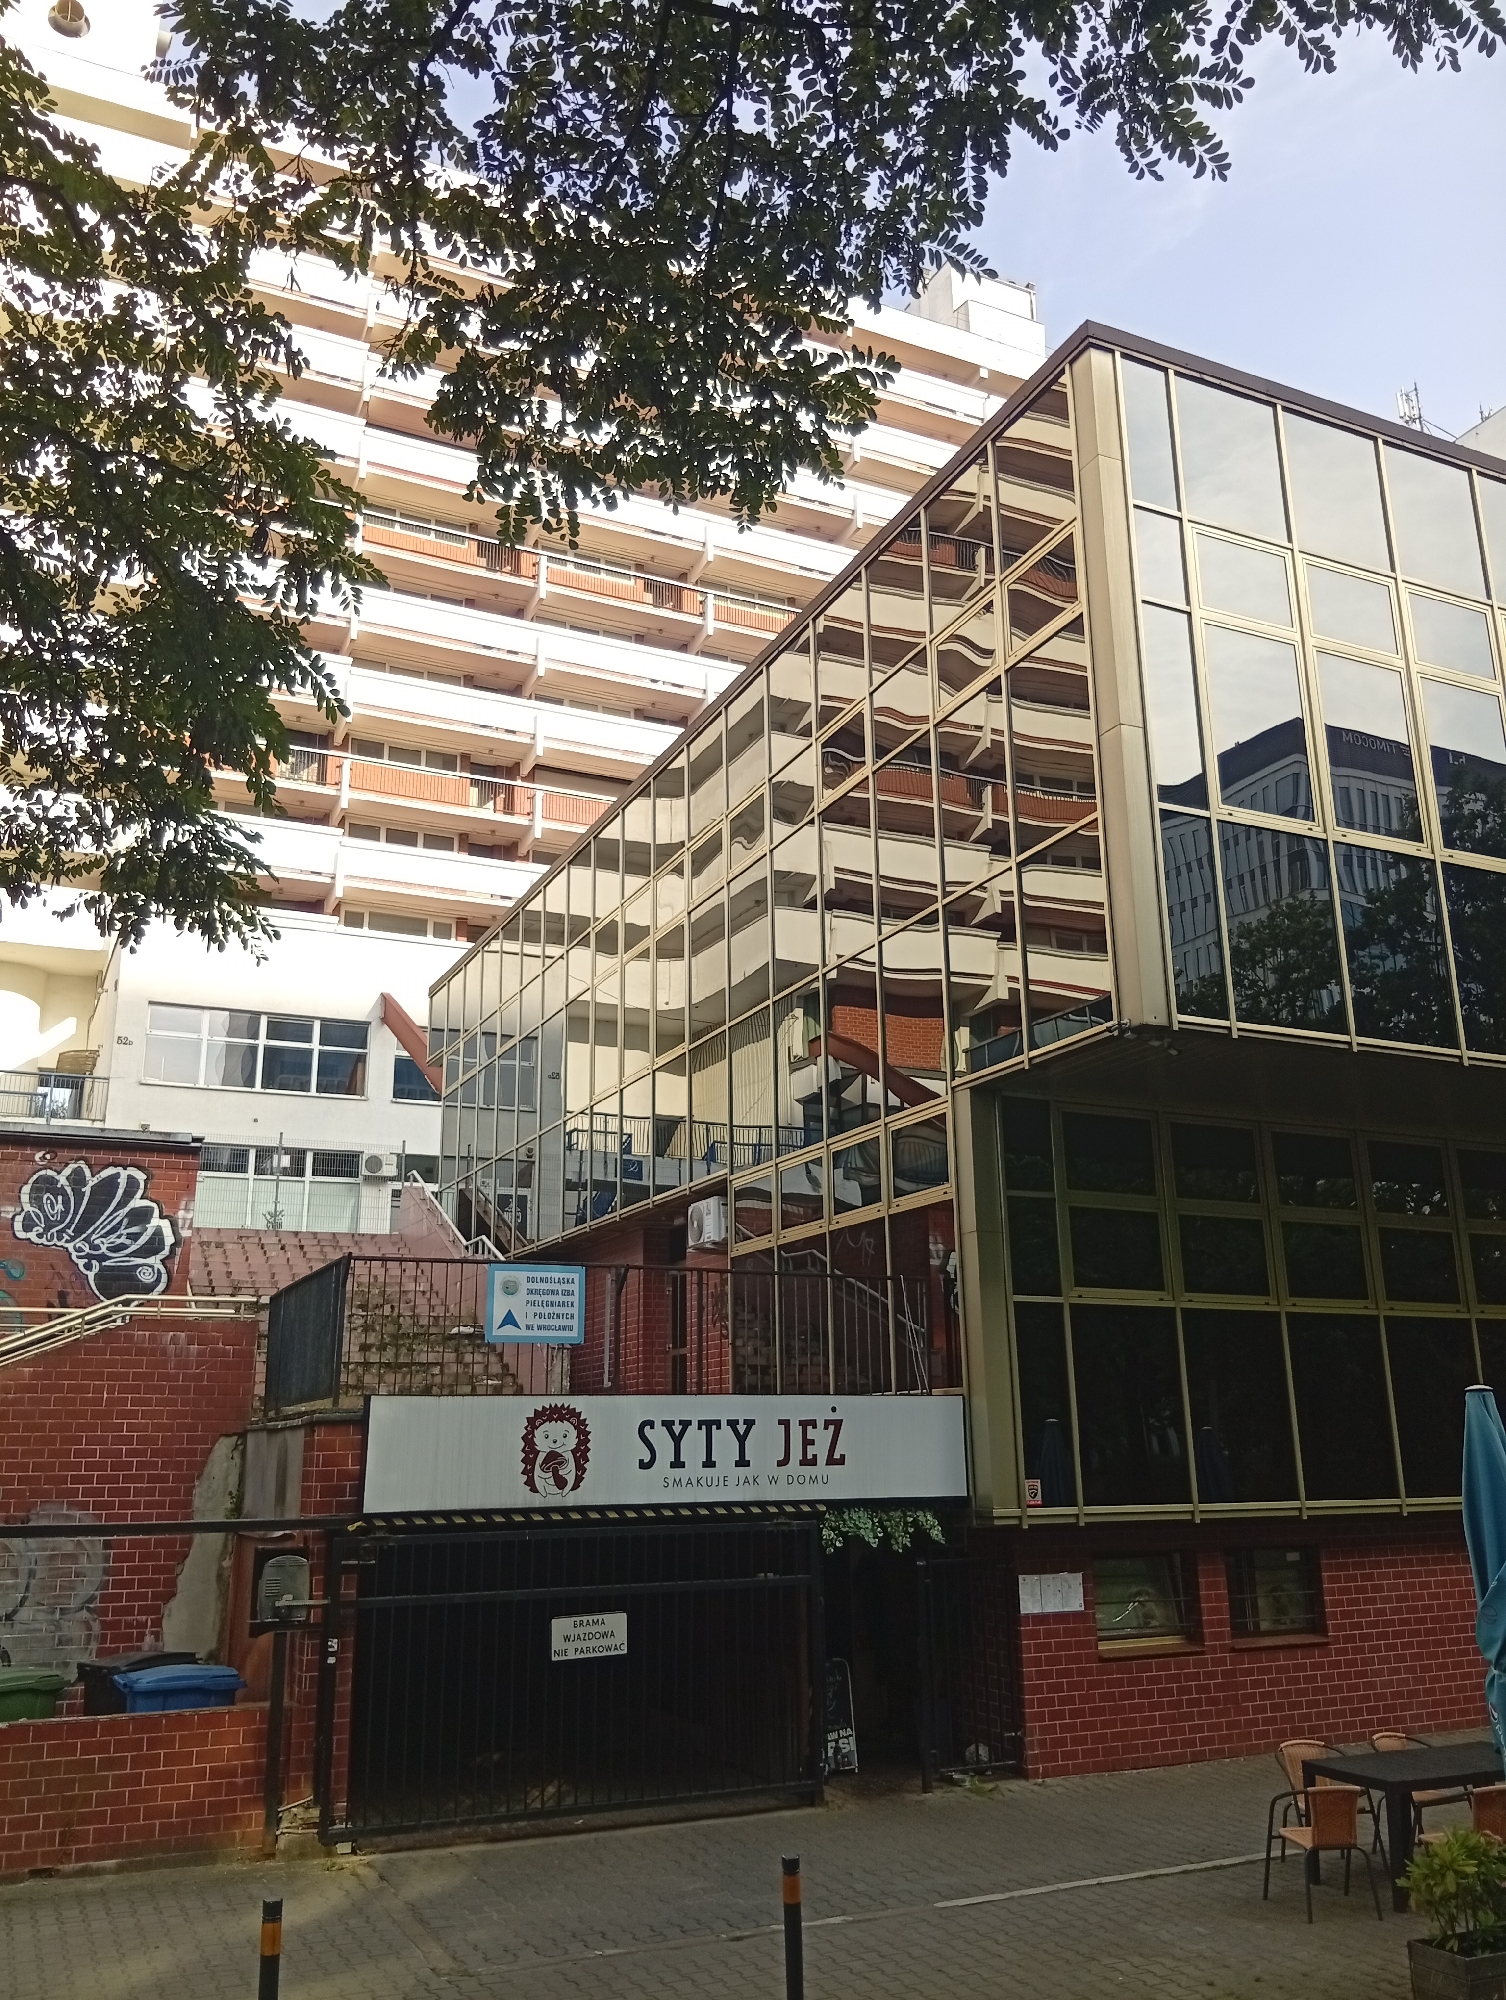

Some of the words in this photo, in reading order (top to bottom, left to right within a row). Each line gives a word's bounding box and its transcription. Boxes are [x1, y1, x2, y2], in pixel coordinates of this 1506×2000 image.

[116, 1036, 134, 1046] 52D
[526, 1275, 575, 1286] DOLNOŚLĄSKA
[526, 1287, 560, 1297] OKRĘGOWA
[560, 1289, 575, 1297] IZBA
[525, 1299, 575, 1309] PIELĘGNIAREK
[525, 1311, 528, 1319] I
[533, 1311, 575, 1320] POŁOŻNYCH
[525, 1323, 535, 1331] WE
[536, 1324, 574, 1332] WROCŁAWIU
[637, 1418, 756, 1470] SYTY
[776, 1405, 846, 1468] JEŻ
[663, 1475, 729, 1488] SMAKUJE
[735, 1474, 760, 1486] JAK
[767, 1474, 780, 1485] W
[786, 1473, 830, 1485] DOMU
[573, 1618, 606, 1628] BRAMA
[563, 1630, 616, 1643] WJAZDOWA
[553, 1648, 569, 1658] NIE
[574, 1640, 626, 1656] PARKOWAĆ
